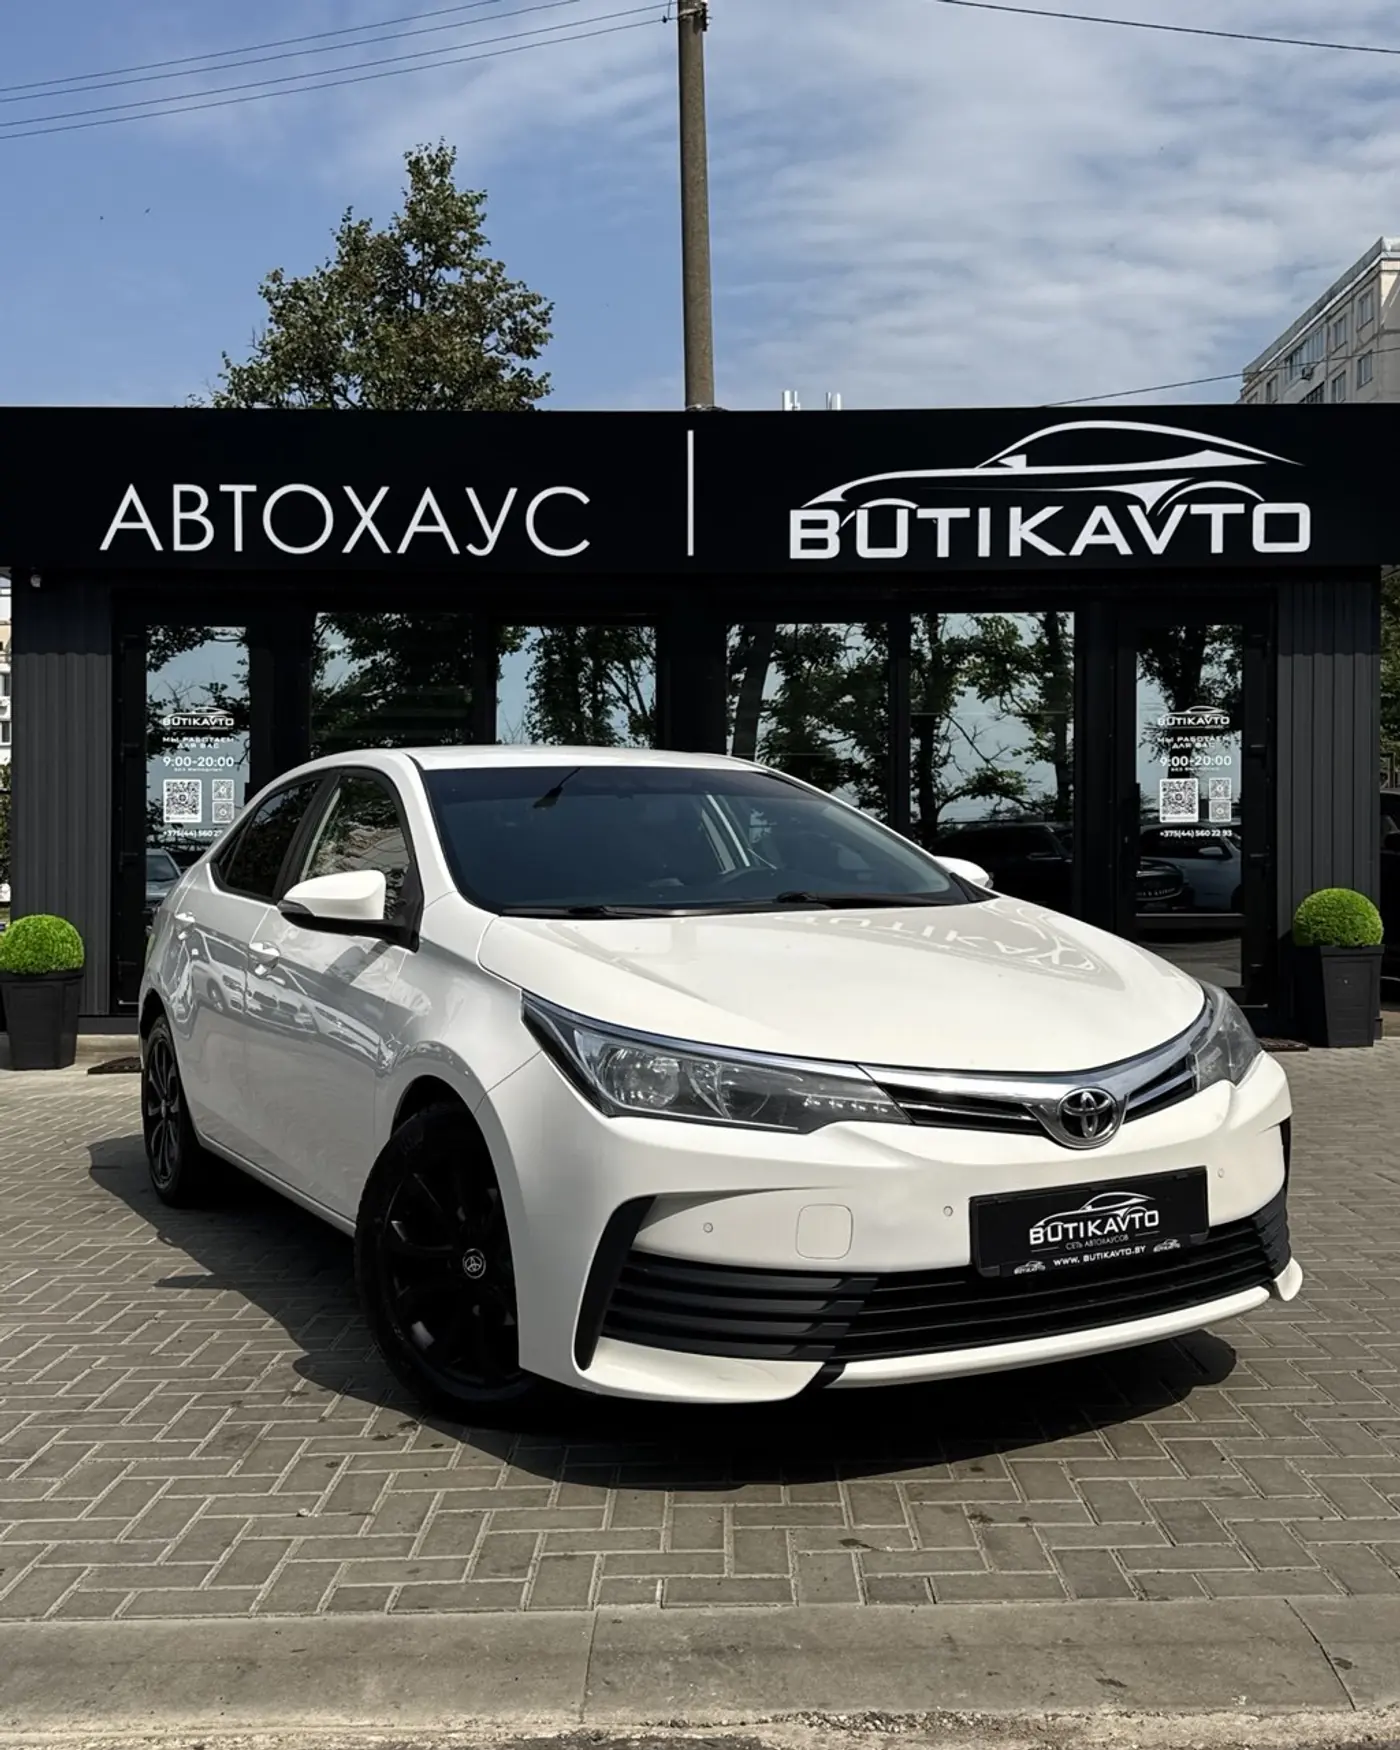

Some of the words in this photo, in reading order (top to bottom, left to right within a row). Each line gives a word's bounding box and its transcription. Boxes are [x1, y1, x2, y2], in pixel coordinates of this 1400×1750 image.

[99, 483, 591, 557] АВТОХАУС
[789, 501, 1311, 560] BUTIKAVTO
[162, 717, 235, 726] BUTIKAVTO
[1157, 716, 1230, 726] BUTIKAVTO
[162, 756, 234, 767] 9:00-20:00
[1159, 756, 1232, 767] 9:00-20:00
[1160, 829, 1195, 838] +375(44)
[1195, 829, 1211, 837] 560
[1211, 829, 1221, 837] 22
[1029, 1209, 1160, 1245] BUTIKAVTO
[1053, 1256, 1080, 1266] WWW.
[1083, 1245, 1146, 1262] BUTIKAVTO.BY
